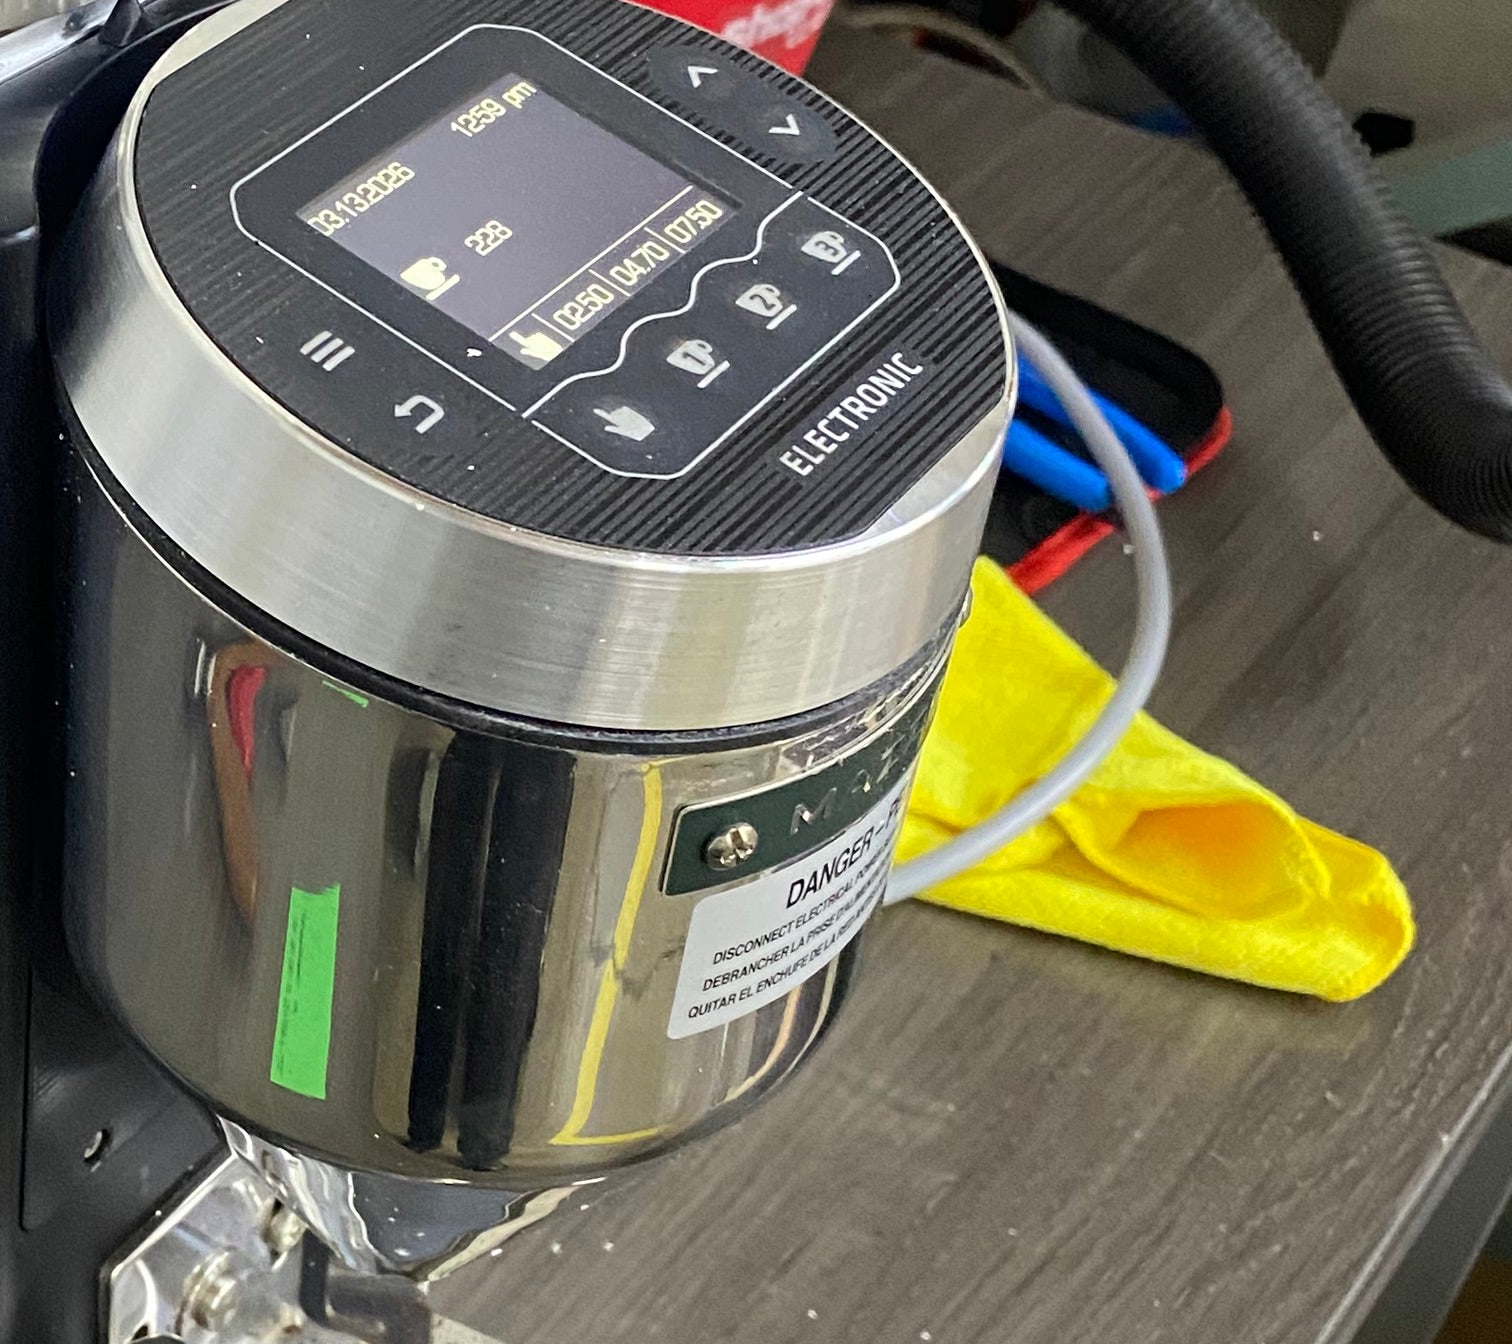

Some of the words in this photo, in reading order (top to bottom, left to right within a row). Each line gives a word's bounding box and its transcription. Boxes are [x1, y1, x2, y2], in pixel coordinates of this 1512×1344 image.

[501, 81, 537, 109] pm
[464, 219, 513, 256] 228
[609, 240, 670, 286] 04.70
[664, 199, 723, 244] 07.50
[749, 289, 776, 312] 2
[815, 243, 841, 257] 3
[779, 351, 924, 476] ELECTRONIC
[786, 826, 875, 908] DANGER
[702, 945, 790, 992] DEBRANCHER
[790, 934, 805, 954] LA
[806, 913, 836, 945] PRISE
[713, 920, 795, 966] DISCONNECT
[795, 881, 853, 929] ELECTRICAL
[687, 994, 737, 1019] QUITAR
[739, 984, 754, 1002] EL
[756, 956, 810, 994] ENCHUFE
[808, 943, 825, 963] DE
